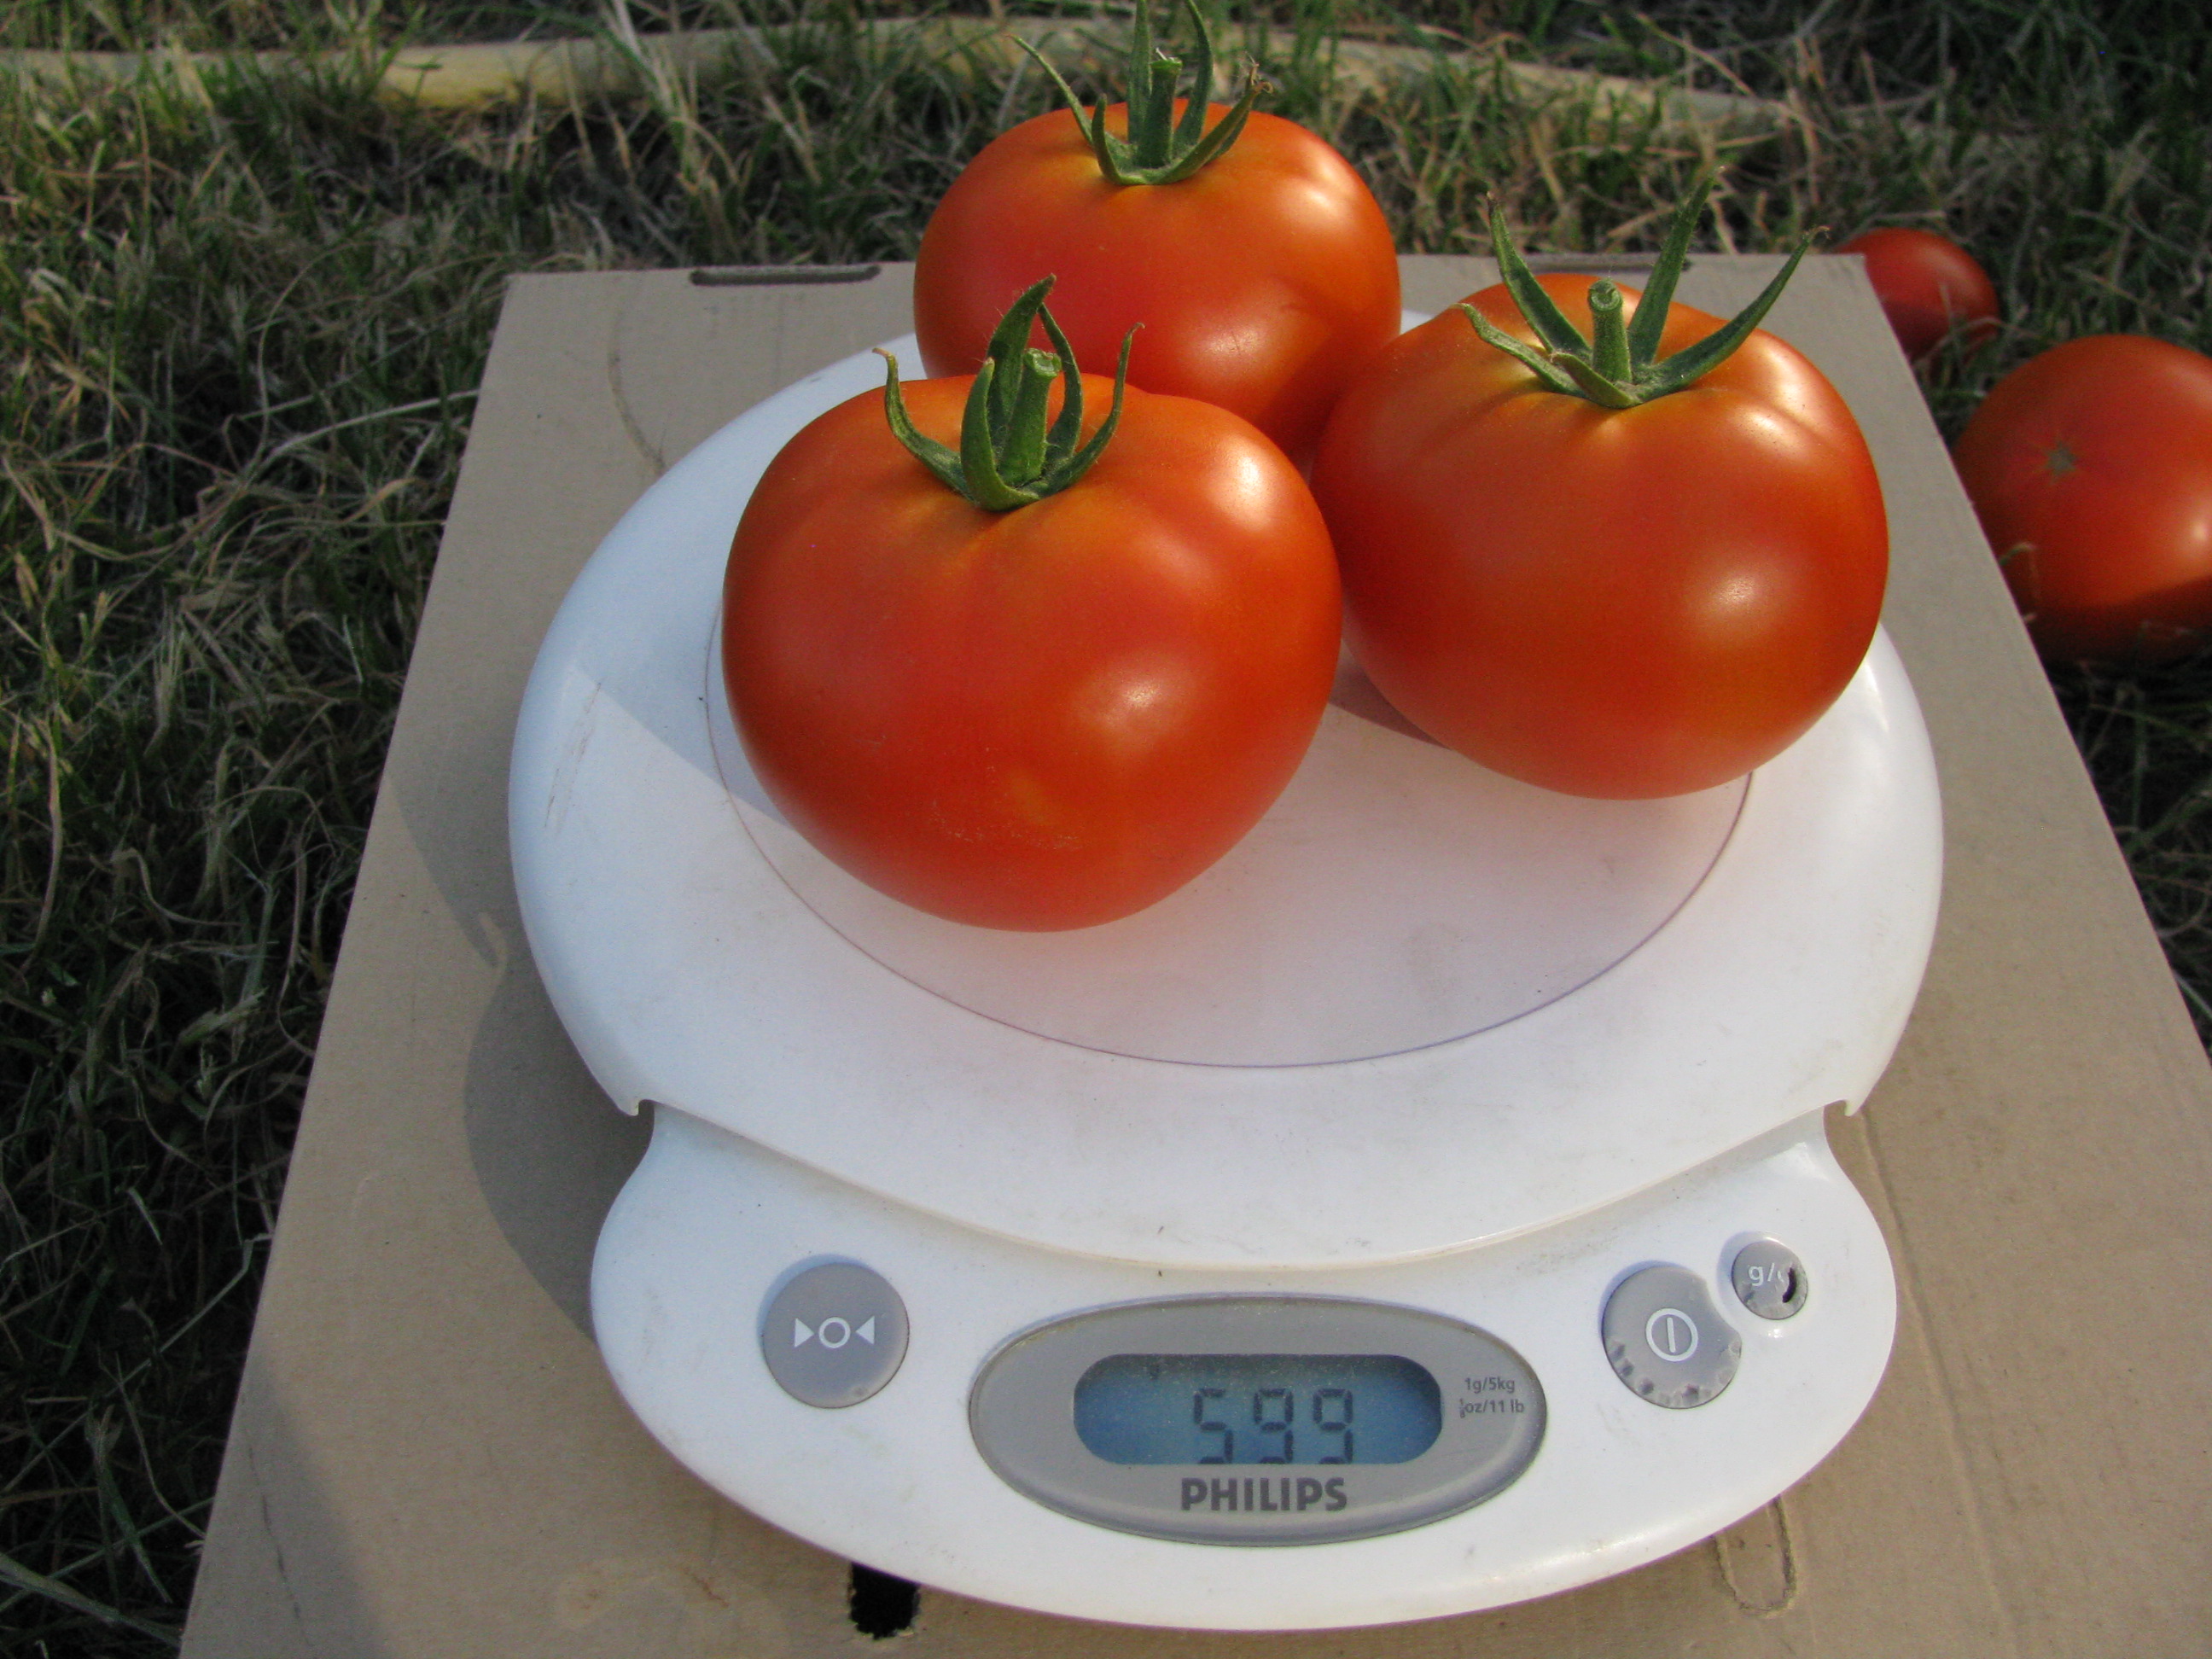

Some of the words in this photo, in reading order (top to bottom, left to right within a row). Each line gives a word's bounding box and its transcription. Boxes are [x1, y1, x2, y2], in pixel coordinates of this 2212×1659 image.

[1464, 1377, 1515, 1394] 1g/5kg
[1195, 1388, 1353, 1464] 599
[1181, 1477, 1348, 1511] PHILIPS
